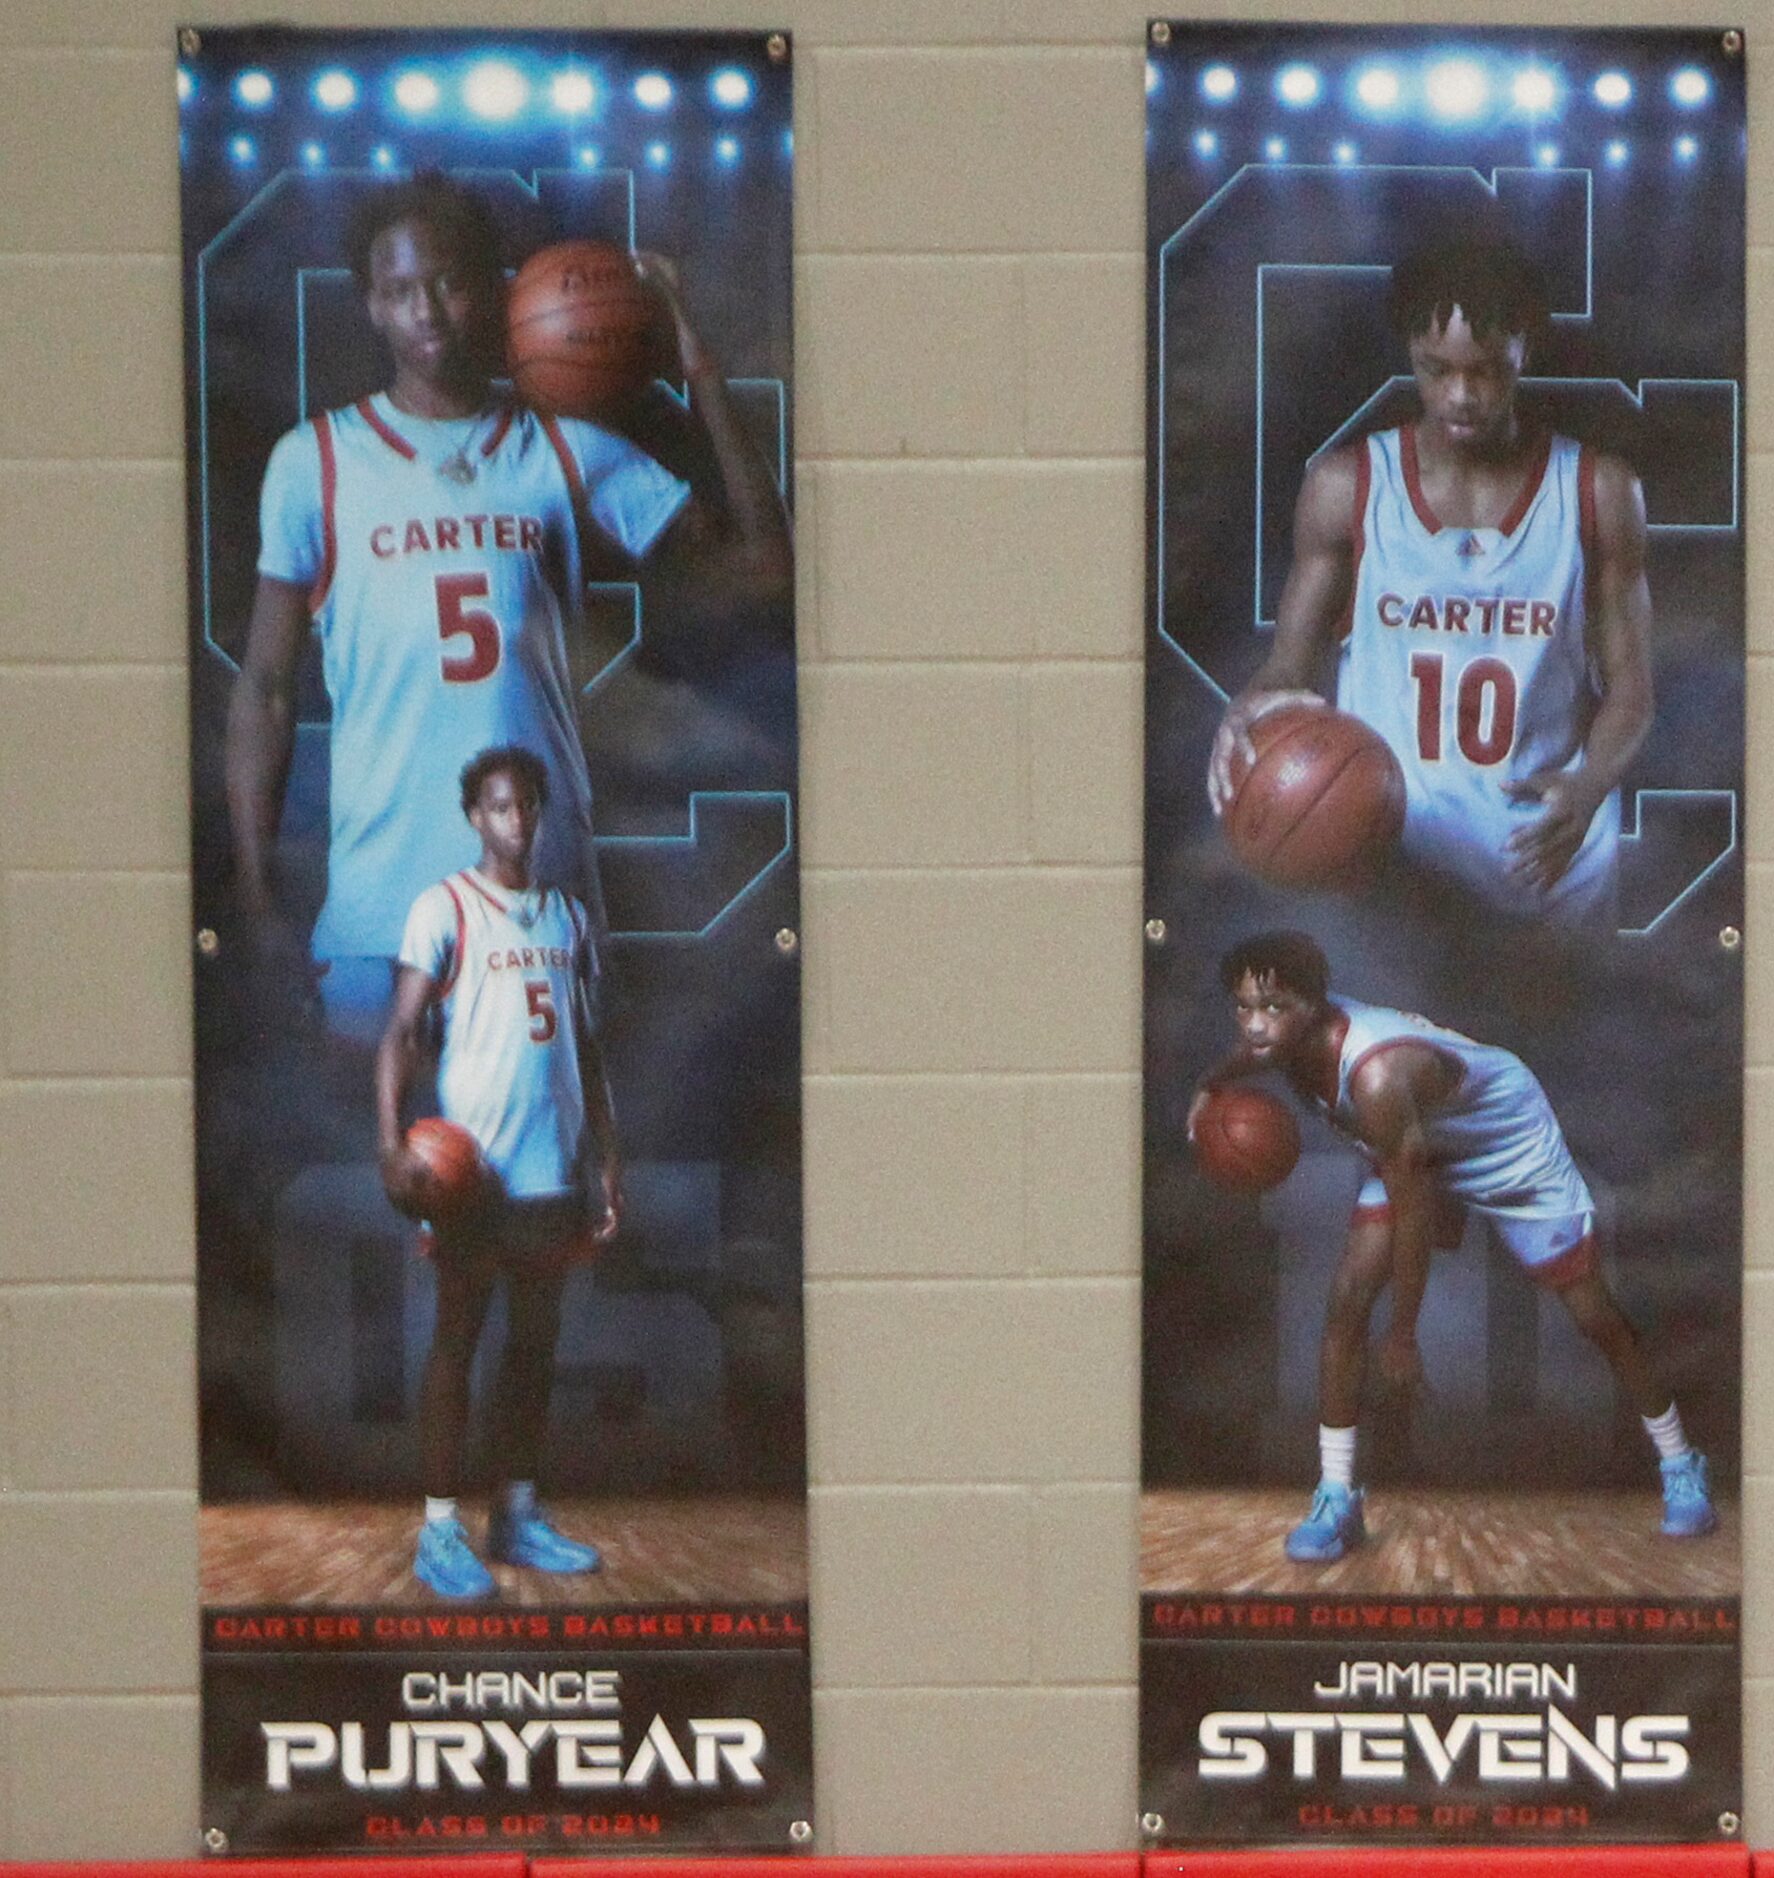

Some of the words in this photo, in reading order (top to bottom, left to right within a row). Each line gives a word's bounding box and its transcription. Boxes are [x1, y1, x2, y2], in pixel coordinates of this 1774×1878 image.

[370, 514, 545, 560] CARTER
[434, 572, 501, 684] 5
[1376, 592, 1558, 638] CARTER
[1410, 651, 1518, 767] 10
[524, 981, 557, 1043] 5
[215, 1616, 361, 1638] CARTER
[375, 1615, 550, 1638] COWBOYS
[563, 1612, 803, 1637] BASKETBALL
[1155, 1604, 1296, 1629] CARTER
[1310, 1604, 1484, 1629] COWBOYS
[1497, 1606, 1735, 1630] BASKETBALL
[402, 1670, 621, 1709] CHANCE
[1313, 1661, 1576, 1698] JAMARIAN
[259, 1713, 767, 1790] PURYEAR
[1196, 1703, 1692, 1791] STEVENS
[365, 1815, 488, 1838] CLASS
[501, 1815, 548, 1837] OF
[561, 1813, 662, 1836] 2024
[1299, 1805, 1419, 1828] CLASS
[1432, 1805, 1478, 1828] OF
[1492, 1806, 1590, 1828] 2024
